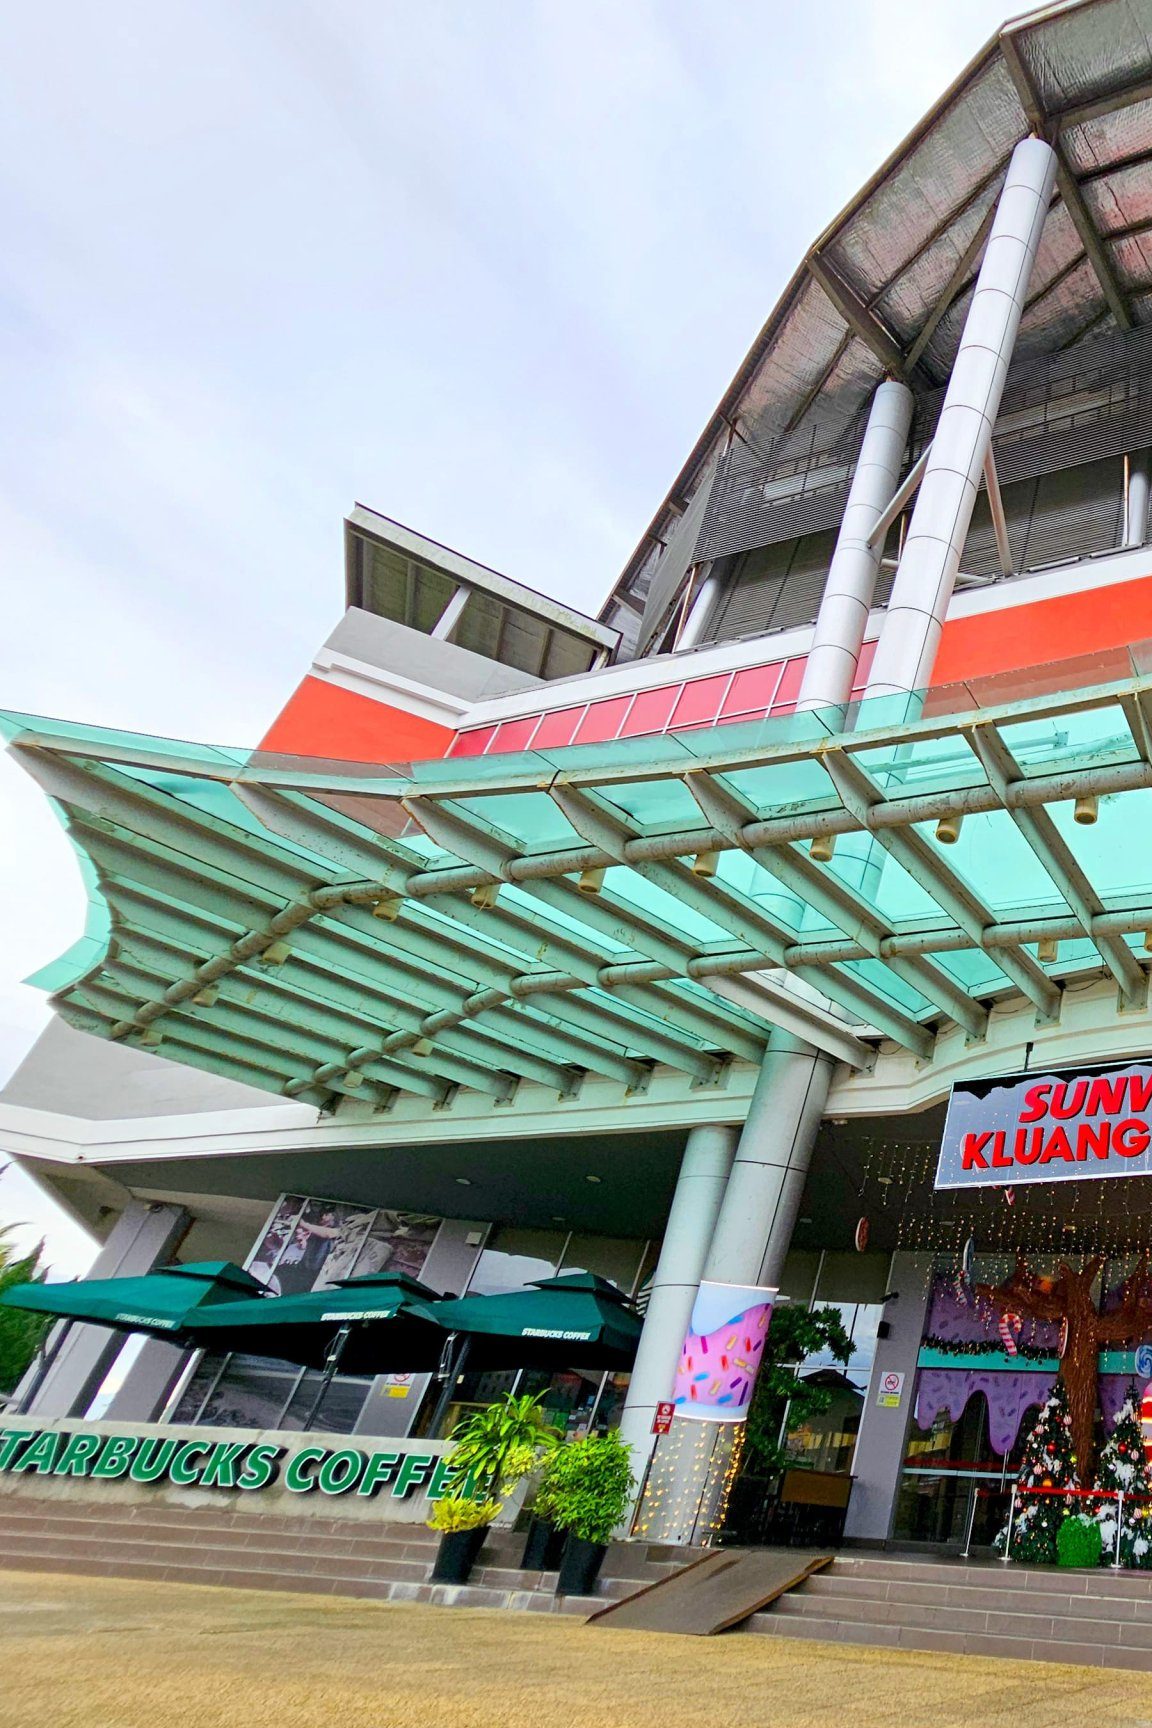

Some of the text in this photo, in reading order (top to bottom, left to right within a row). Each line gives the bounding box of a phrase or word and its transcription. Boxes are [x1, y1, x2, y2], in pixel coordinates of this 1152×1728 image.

[961, 1118, 1151, 1170] KLUANG
[521, 1327, 592, 1341] STARBUCKS COFFEE
[0, 1428, 280, 1490] TARBUCKS
